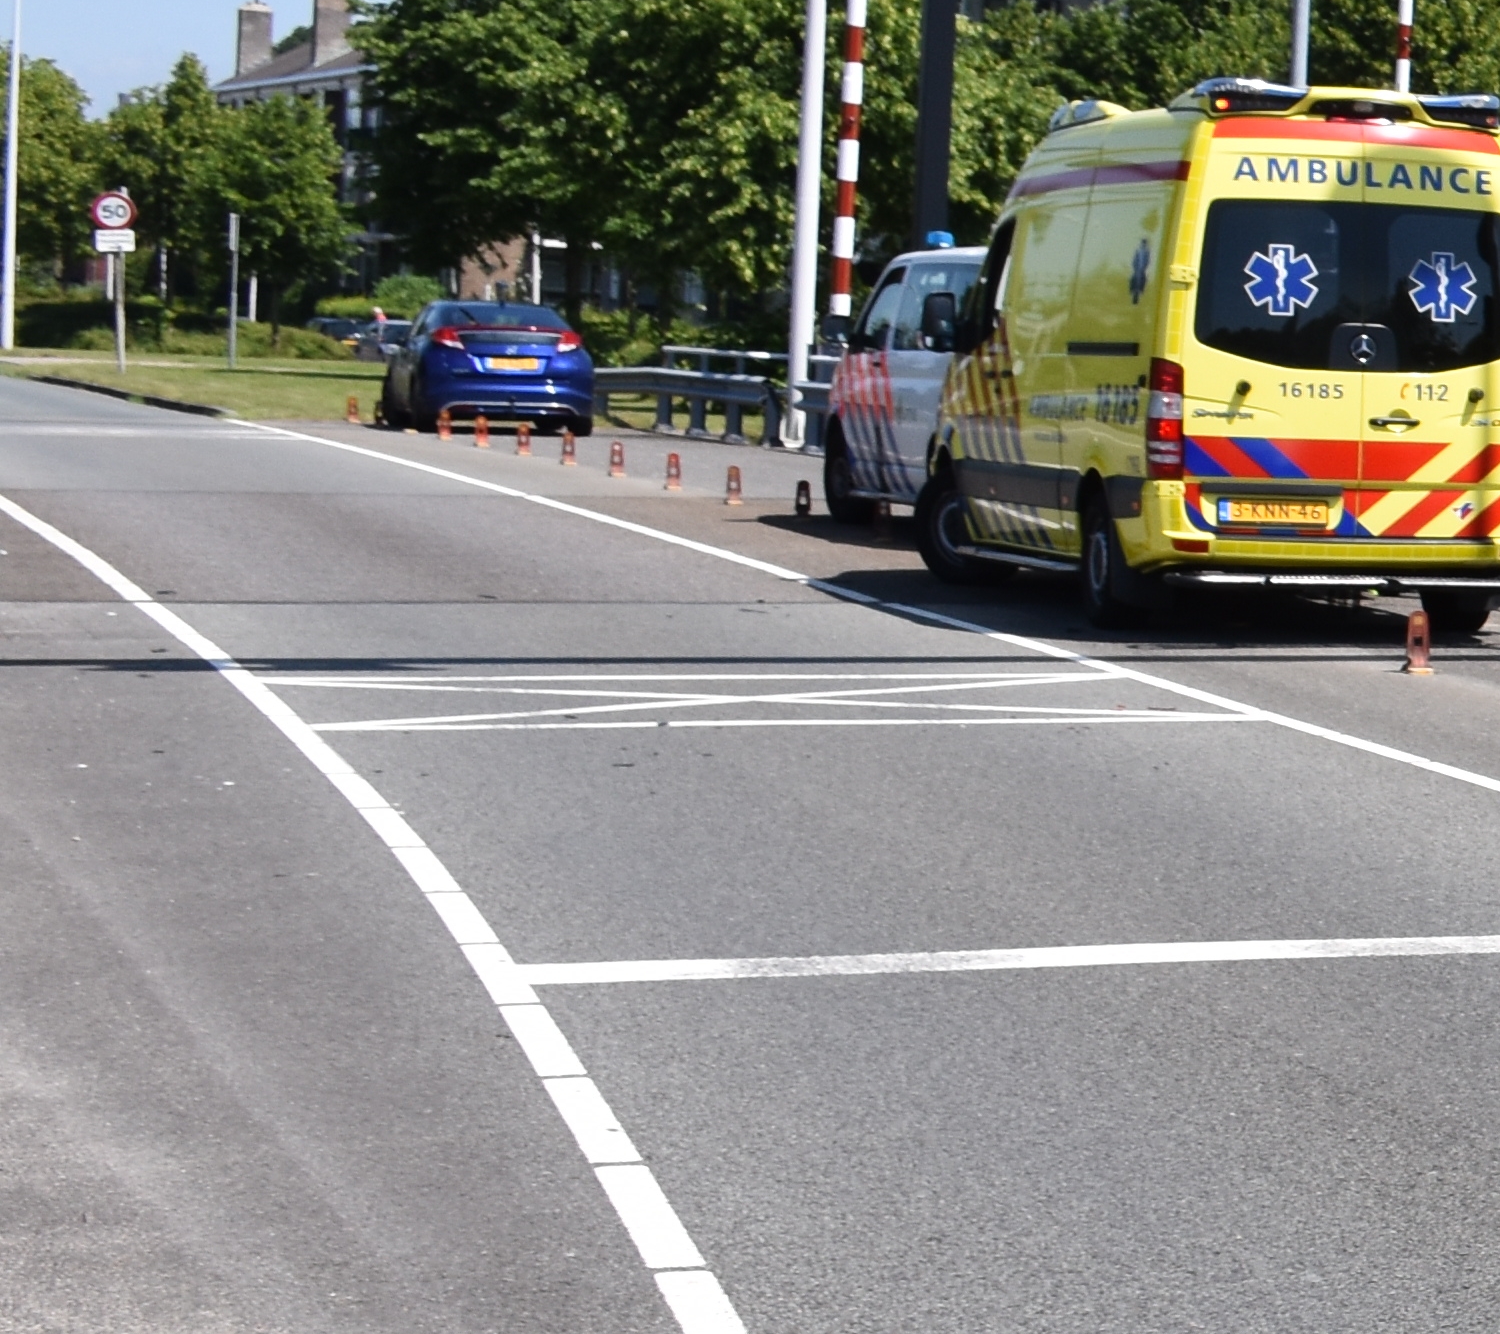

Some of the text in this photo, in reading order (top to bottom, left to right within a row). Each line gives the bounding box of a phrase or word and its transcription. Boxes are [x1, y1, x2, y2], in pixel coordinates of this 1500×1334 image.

[1233, 156, 1493, 196] AMBULANCE
[102, 204, 127, 219] 50
[1278, 381, 1344, 400] 16185
[1232, 502, 1322, 520] 3-KNN-46
